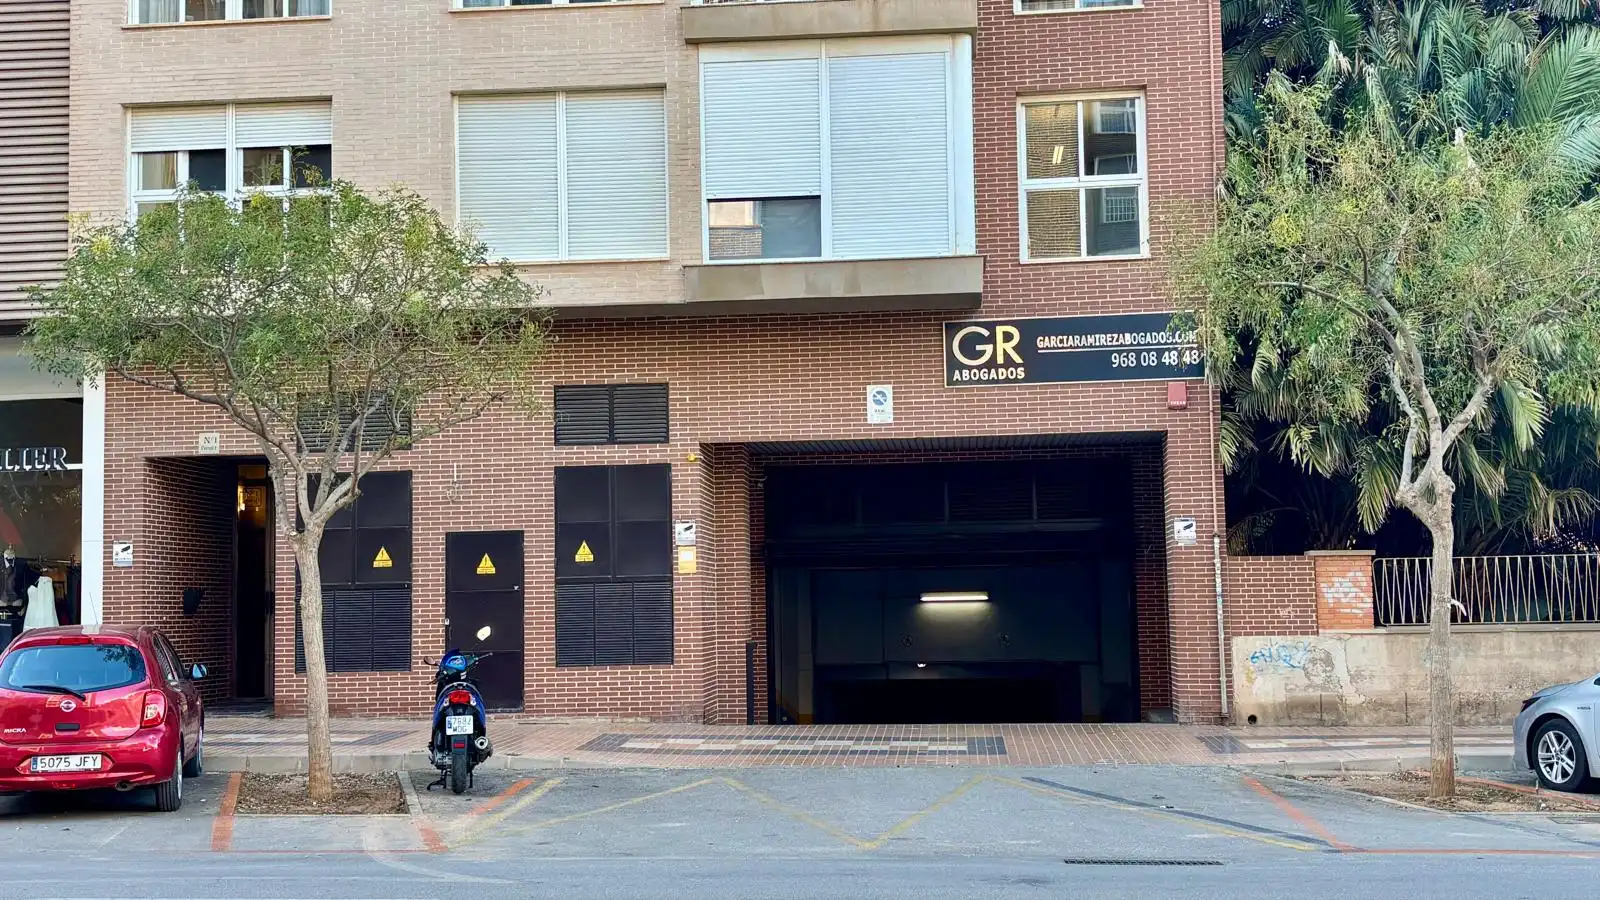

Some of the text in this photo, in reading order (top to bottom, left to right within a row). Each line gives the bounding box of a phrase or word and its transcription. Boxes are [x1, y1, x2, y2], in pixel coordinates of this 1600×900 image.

[952, 325, 1024, 366] GR
[1111, 349, 1200, 368] 968 08 48 48
[952, 367, 1026, 382] ABOGADOS
[0, 447, 69, 471] LIER
[39, 756, 98, 768] 5075 JFY
